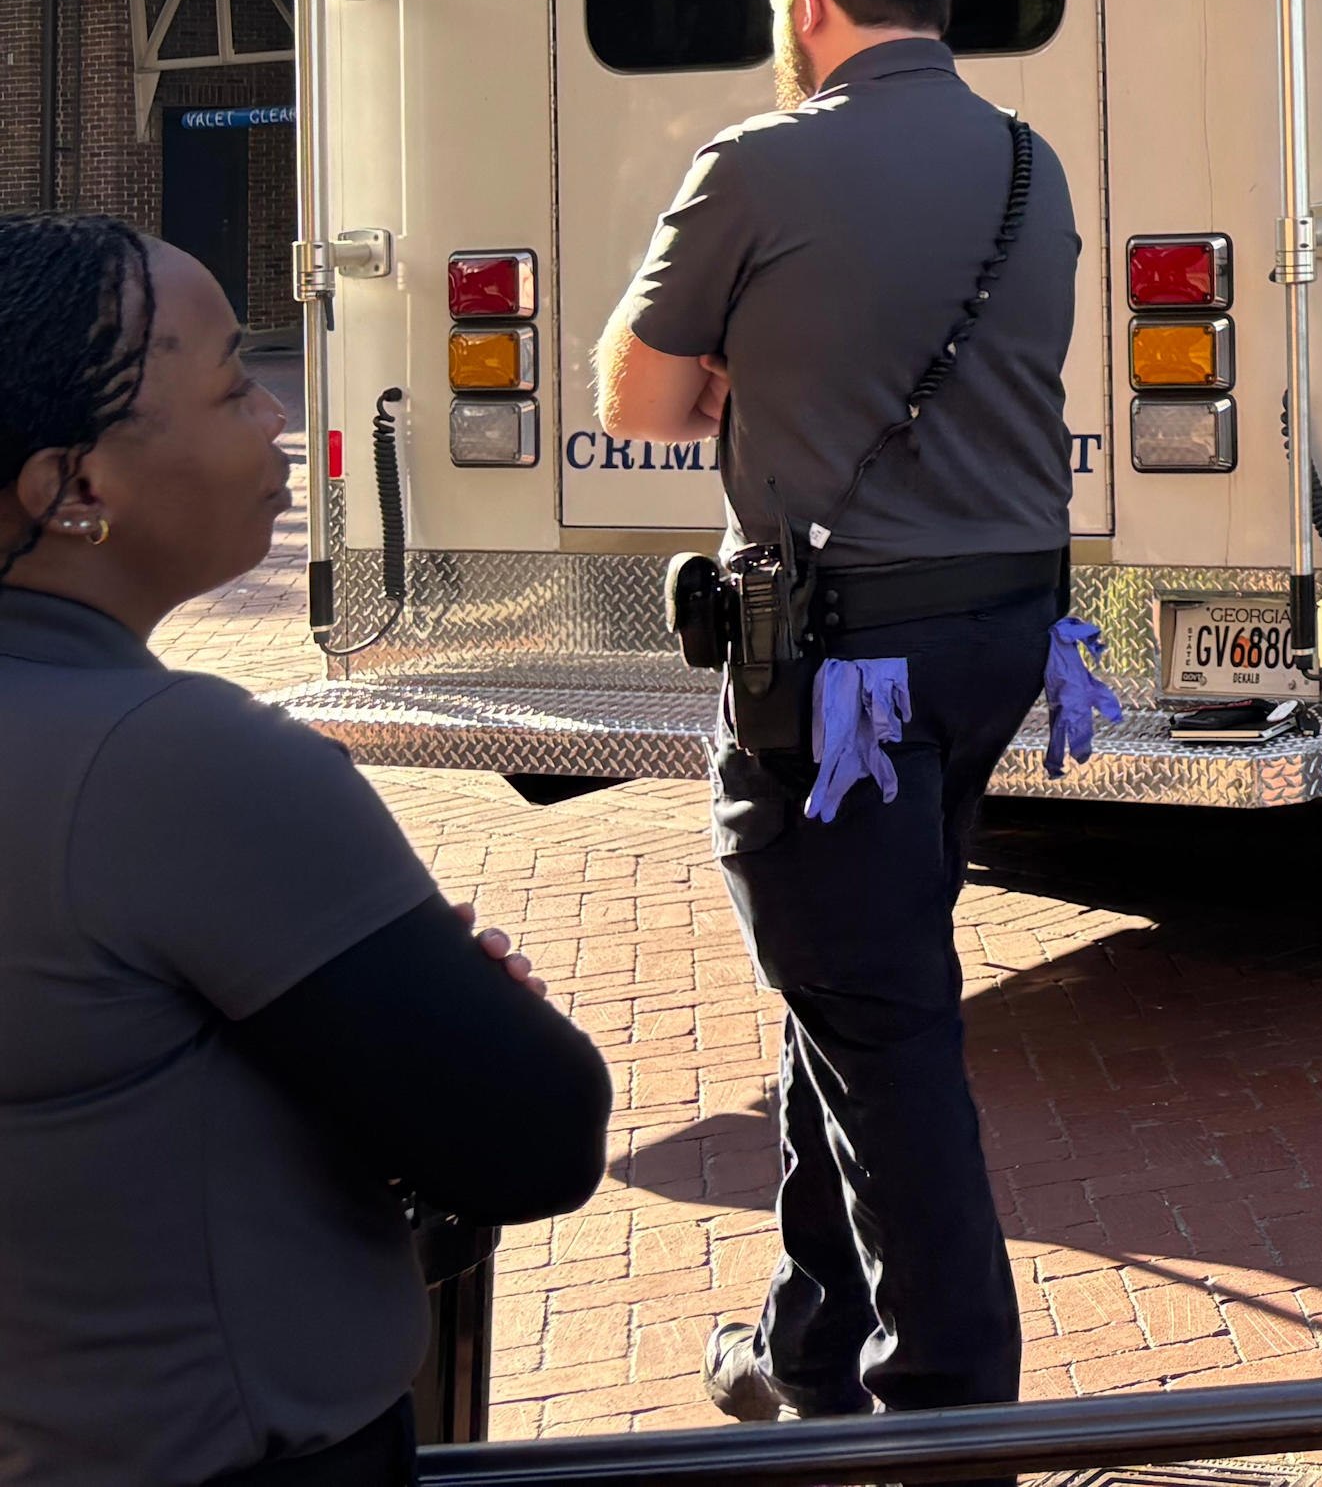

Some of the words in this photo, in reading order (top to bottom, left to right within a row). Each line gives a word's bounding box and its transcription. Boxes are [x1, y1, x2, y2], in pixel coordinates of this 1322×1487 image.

[186, 110, 235, 128] VALET
[1210, 606, 1291, 625] GEORGIA
[1232, 671, 1261, 685] DEKALB
